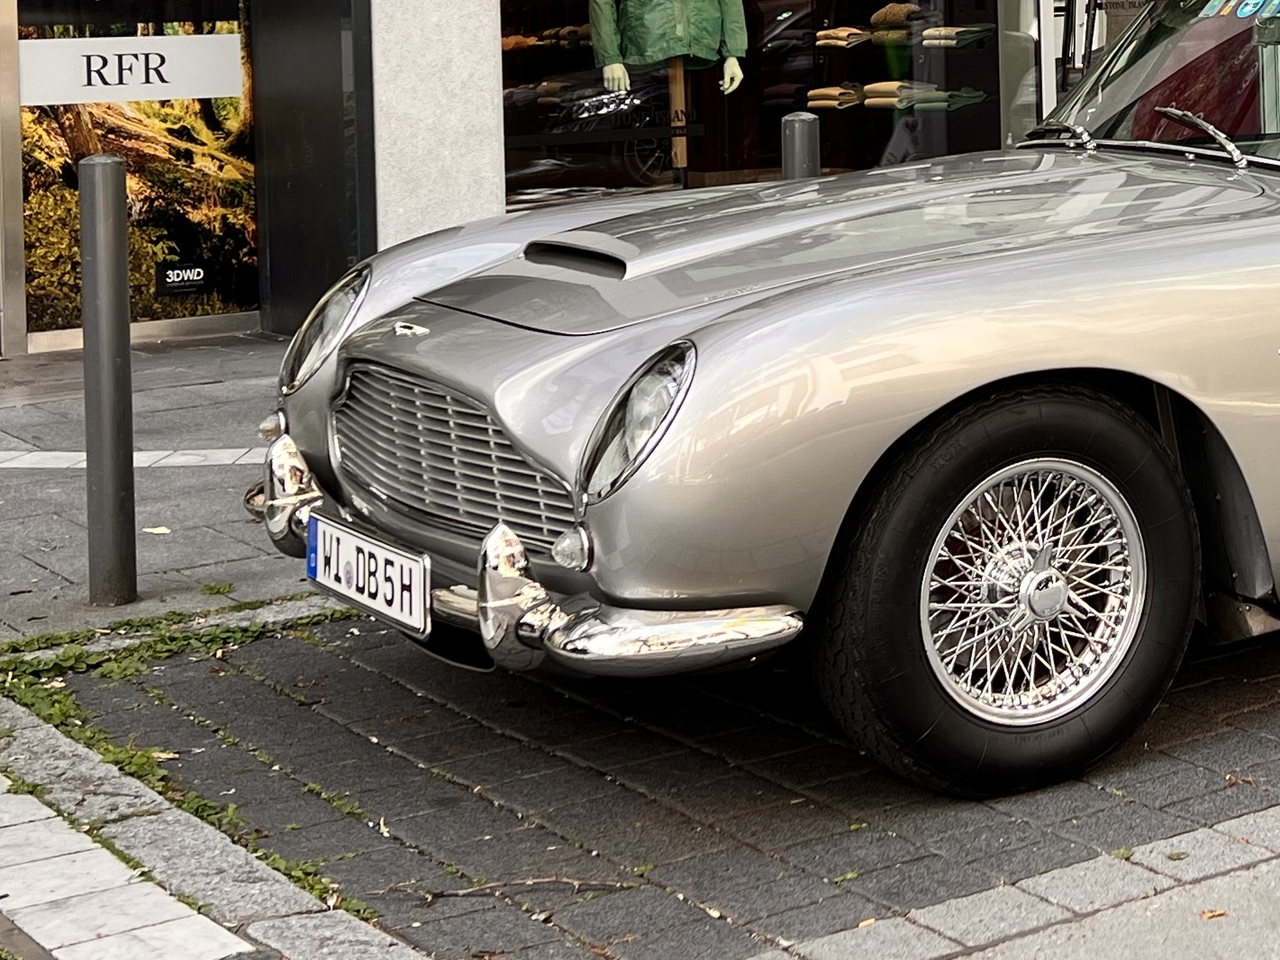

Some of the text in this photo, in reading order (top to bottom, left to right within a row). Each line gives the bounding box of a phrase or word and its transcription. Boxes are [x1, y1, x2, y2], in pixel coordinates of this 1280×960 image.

[81, 52, 171, 87] RFR
[165, 267, 205, 283] 3DWD
[323, 529, 342, 584] WI
